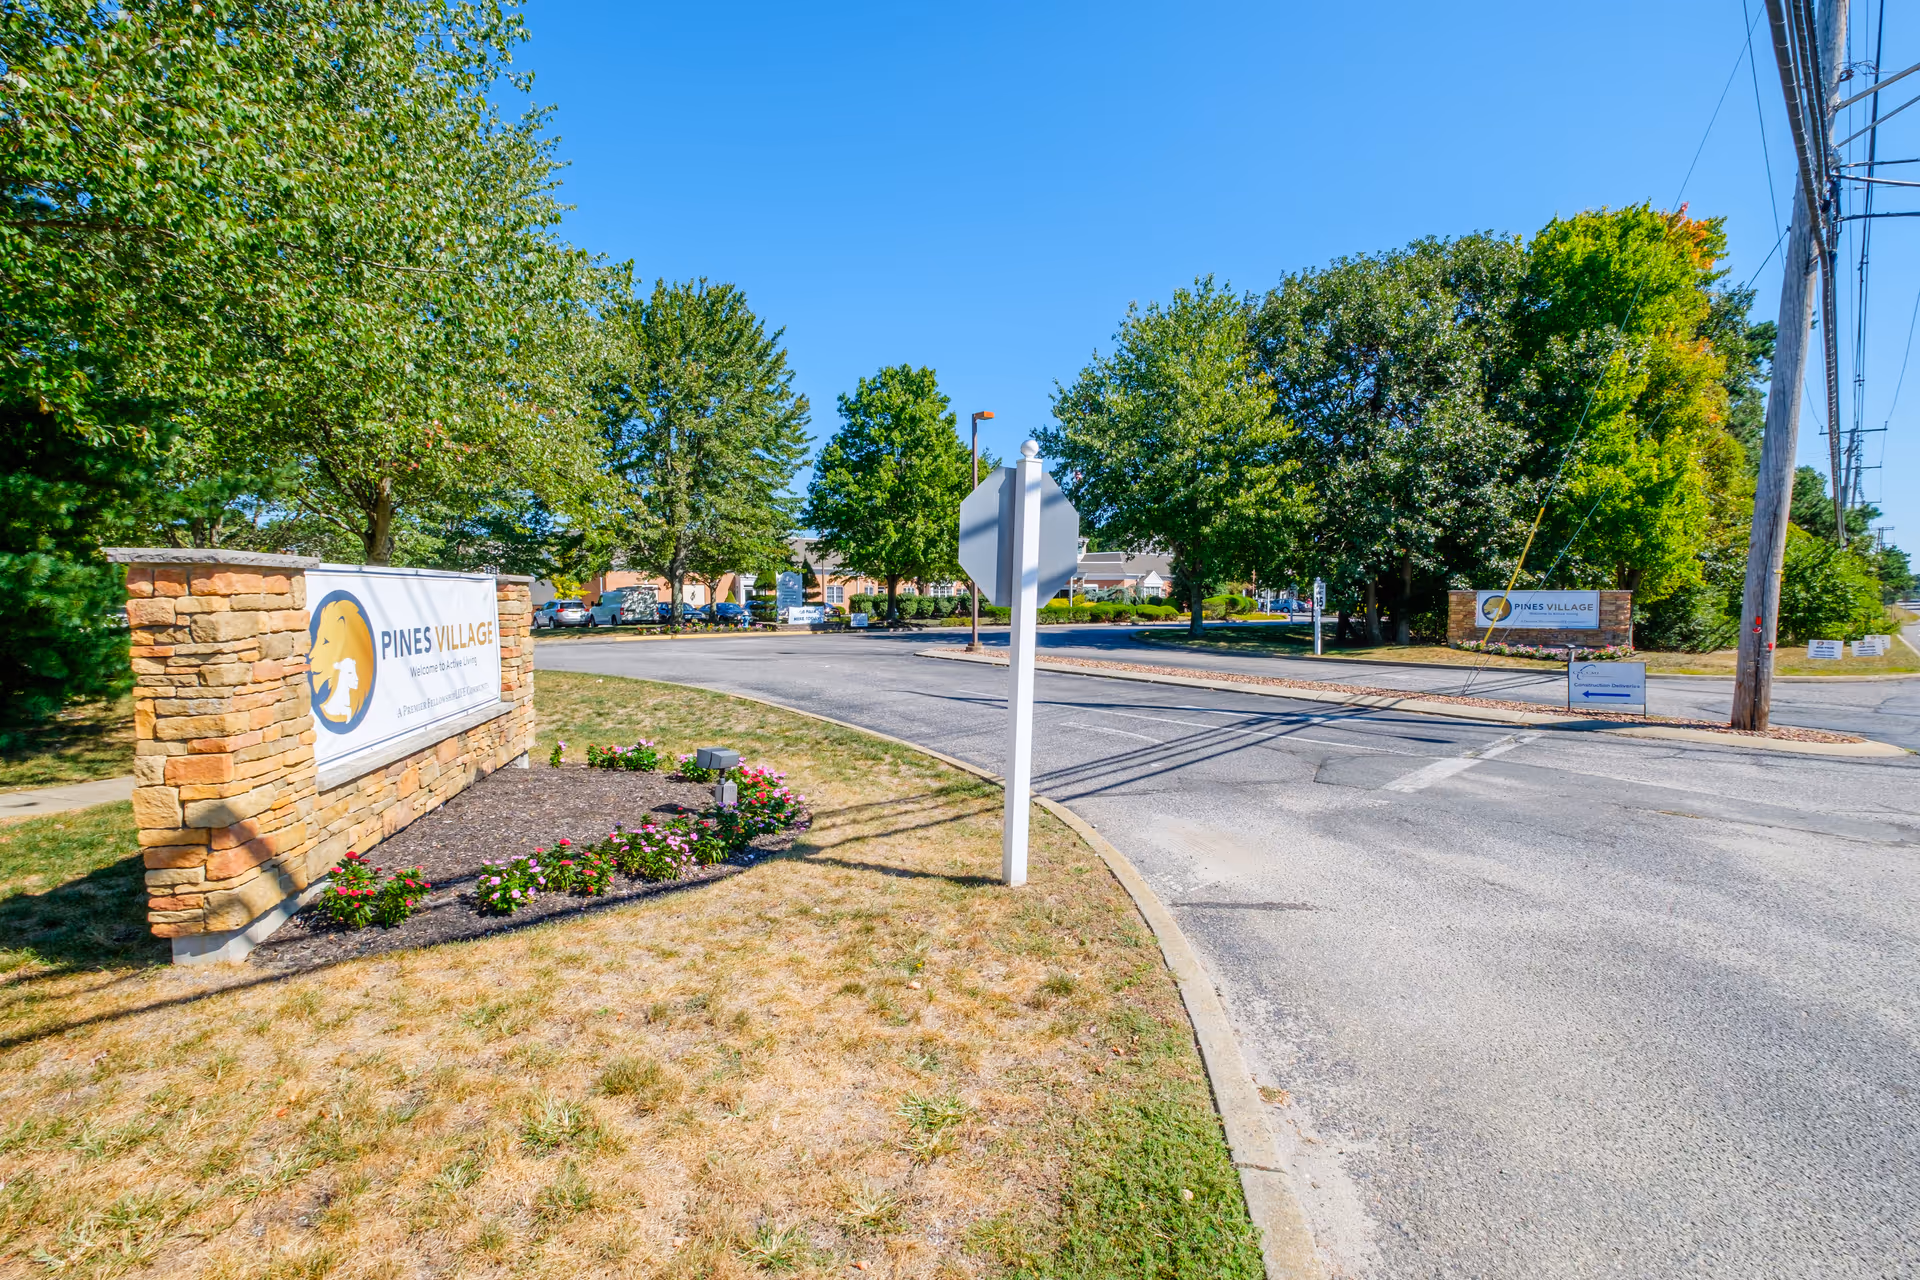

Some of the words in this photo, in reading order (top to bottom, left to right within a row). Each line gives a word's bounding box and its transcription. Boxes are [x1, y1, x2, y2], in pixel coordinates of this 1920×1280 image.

[1316, 597, 1324, 607] 15
[1546, 603, 1594, 611] VILLAGE
[381, 626, 432, 660] PINES
[434, 621, 493, 652] VILLAGE
[410, 664, 439, 678] Welcome
[439, 660, 446, 671] to
[446, 658, 462, 671] Active
[463, 656, 478, 666] Living
[397, 707, 403, 718] A
